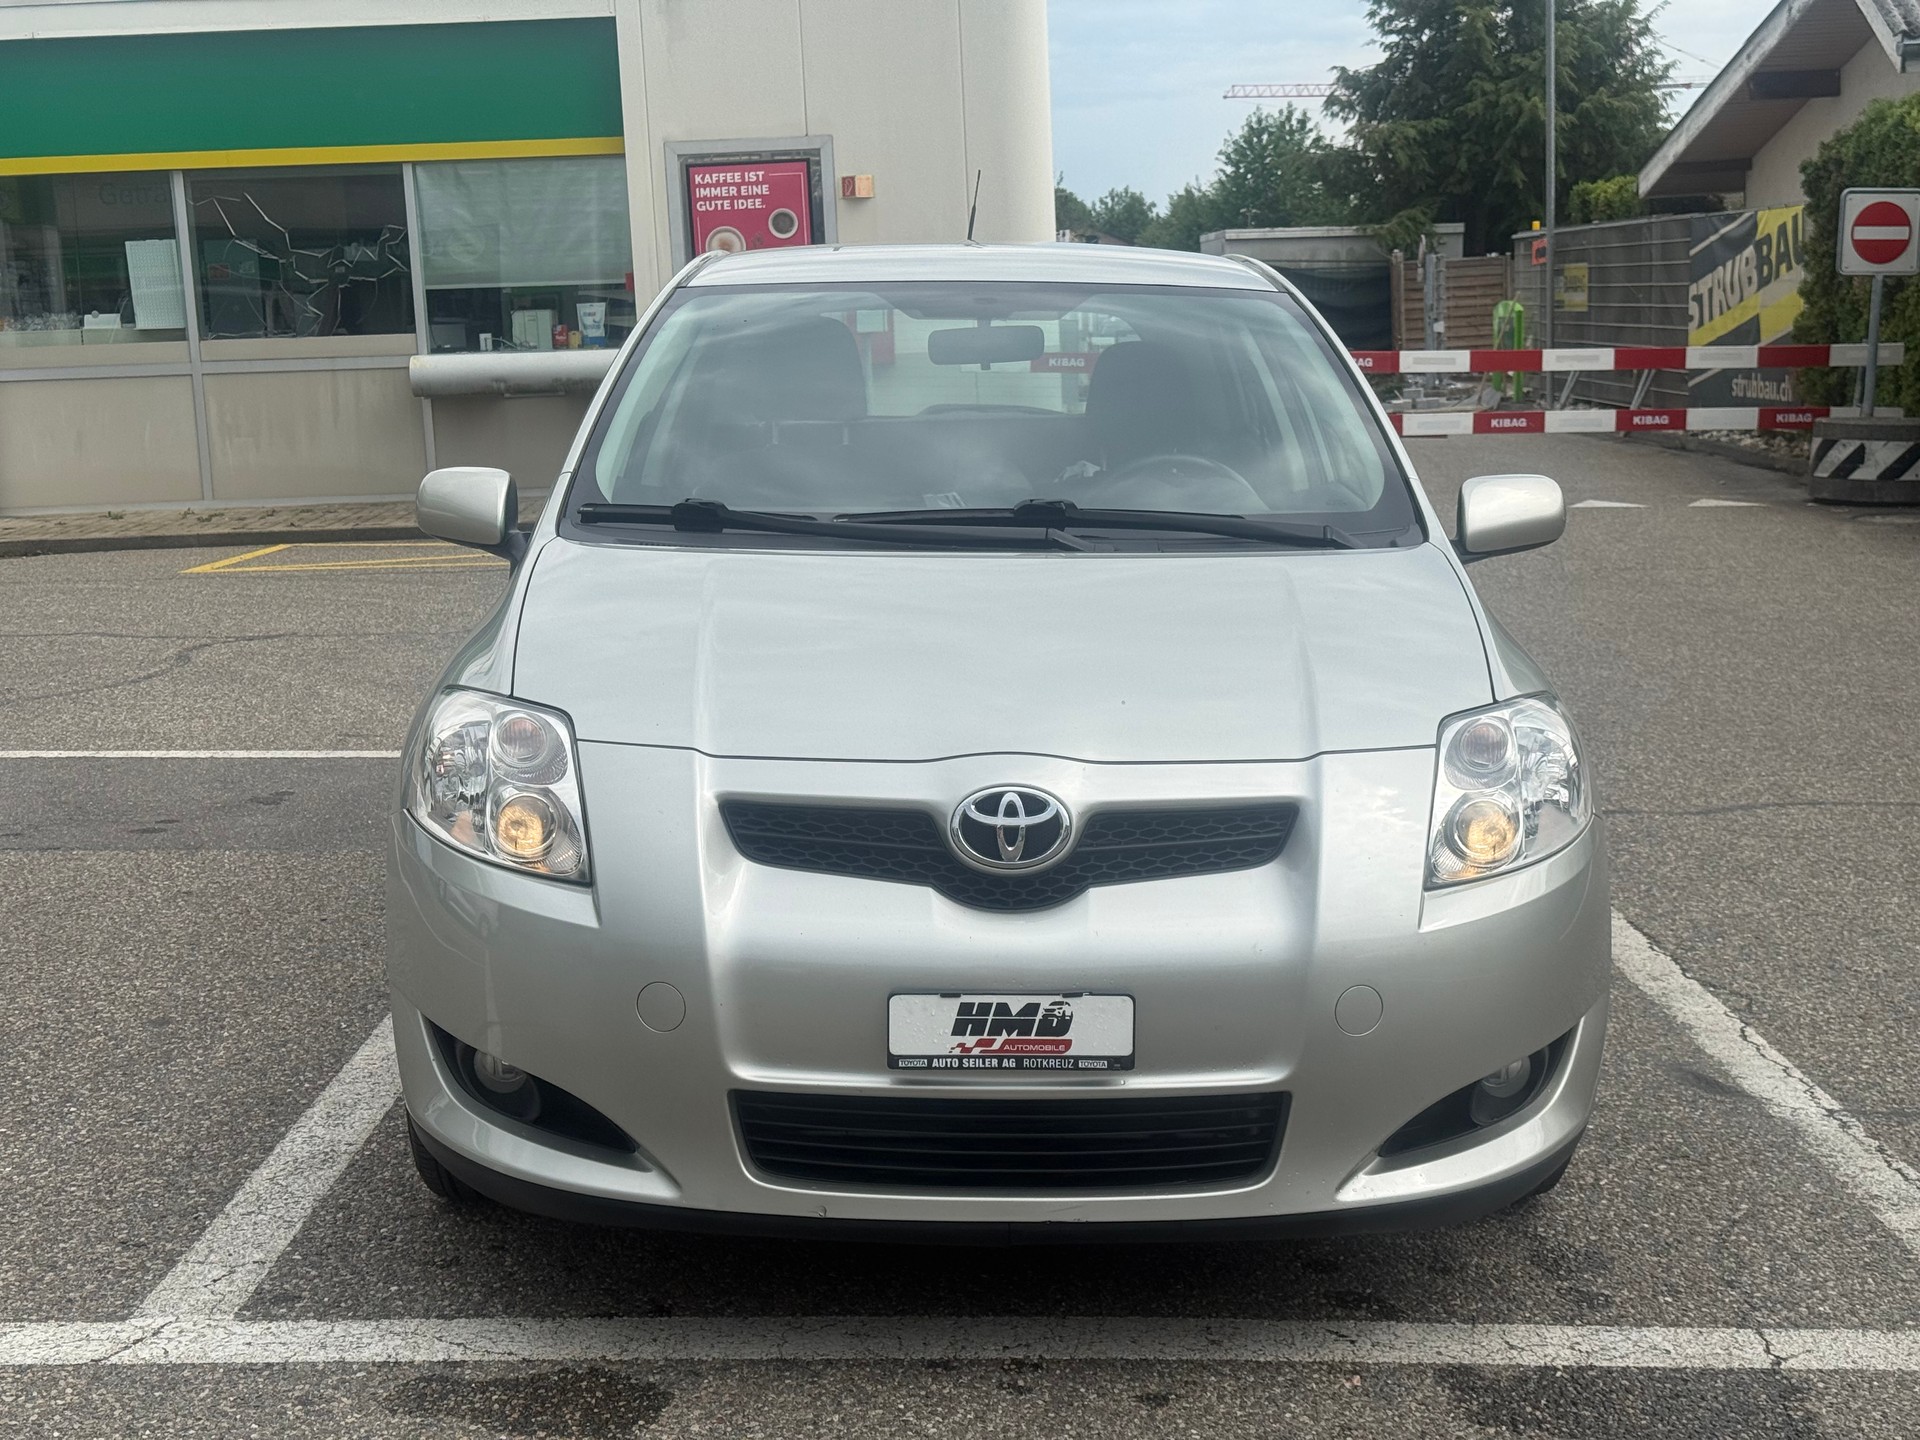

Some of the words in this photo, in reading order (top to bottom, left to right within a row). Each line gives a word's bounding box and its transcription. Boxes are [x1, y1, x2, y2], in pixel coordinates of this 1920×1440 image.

[695, 172, 742, 185] KAFFEE
[744, 171, 765, 182] IST
[696, 185, 738, 198] IMMER
[740, 184, 770, 196] EINE
[696, 199, 732, 212] GUTE
[733, 198, 766, 210] IDEE.
[1048, 357, 1085, 367] KIBAG
[1731, 372, 1793, 402] strubbau.ch
[1490, 418, 1528, 428] KIBAG
[1632, 415, 1670, 425] KIBAG
[1775, 413, 1813, 424] KIBAG
[1003, 1044, 1066, 1052] AUTOMOBILE
[932, 1058, 959, 1068] AUTO
[962, 1058, 998, 1068] SEILER
[1002, 1058, 1016, 1068] AG
[1023, 1058, 1074, 1068] ROTKREUZ
